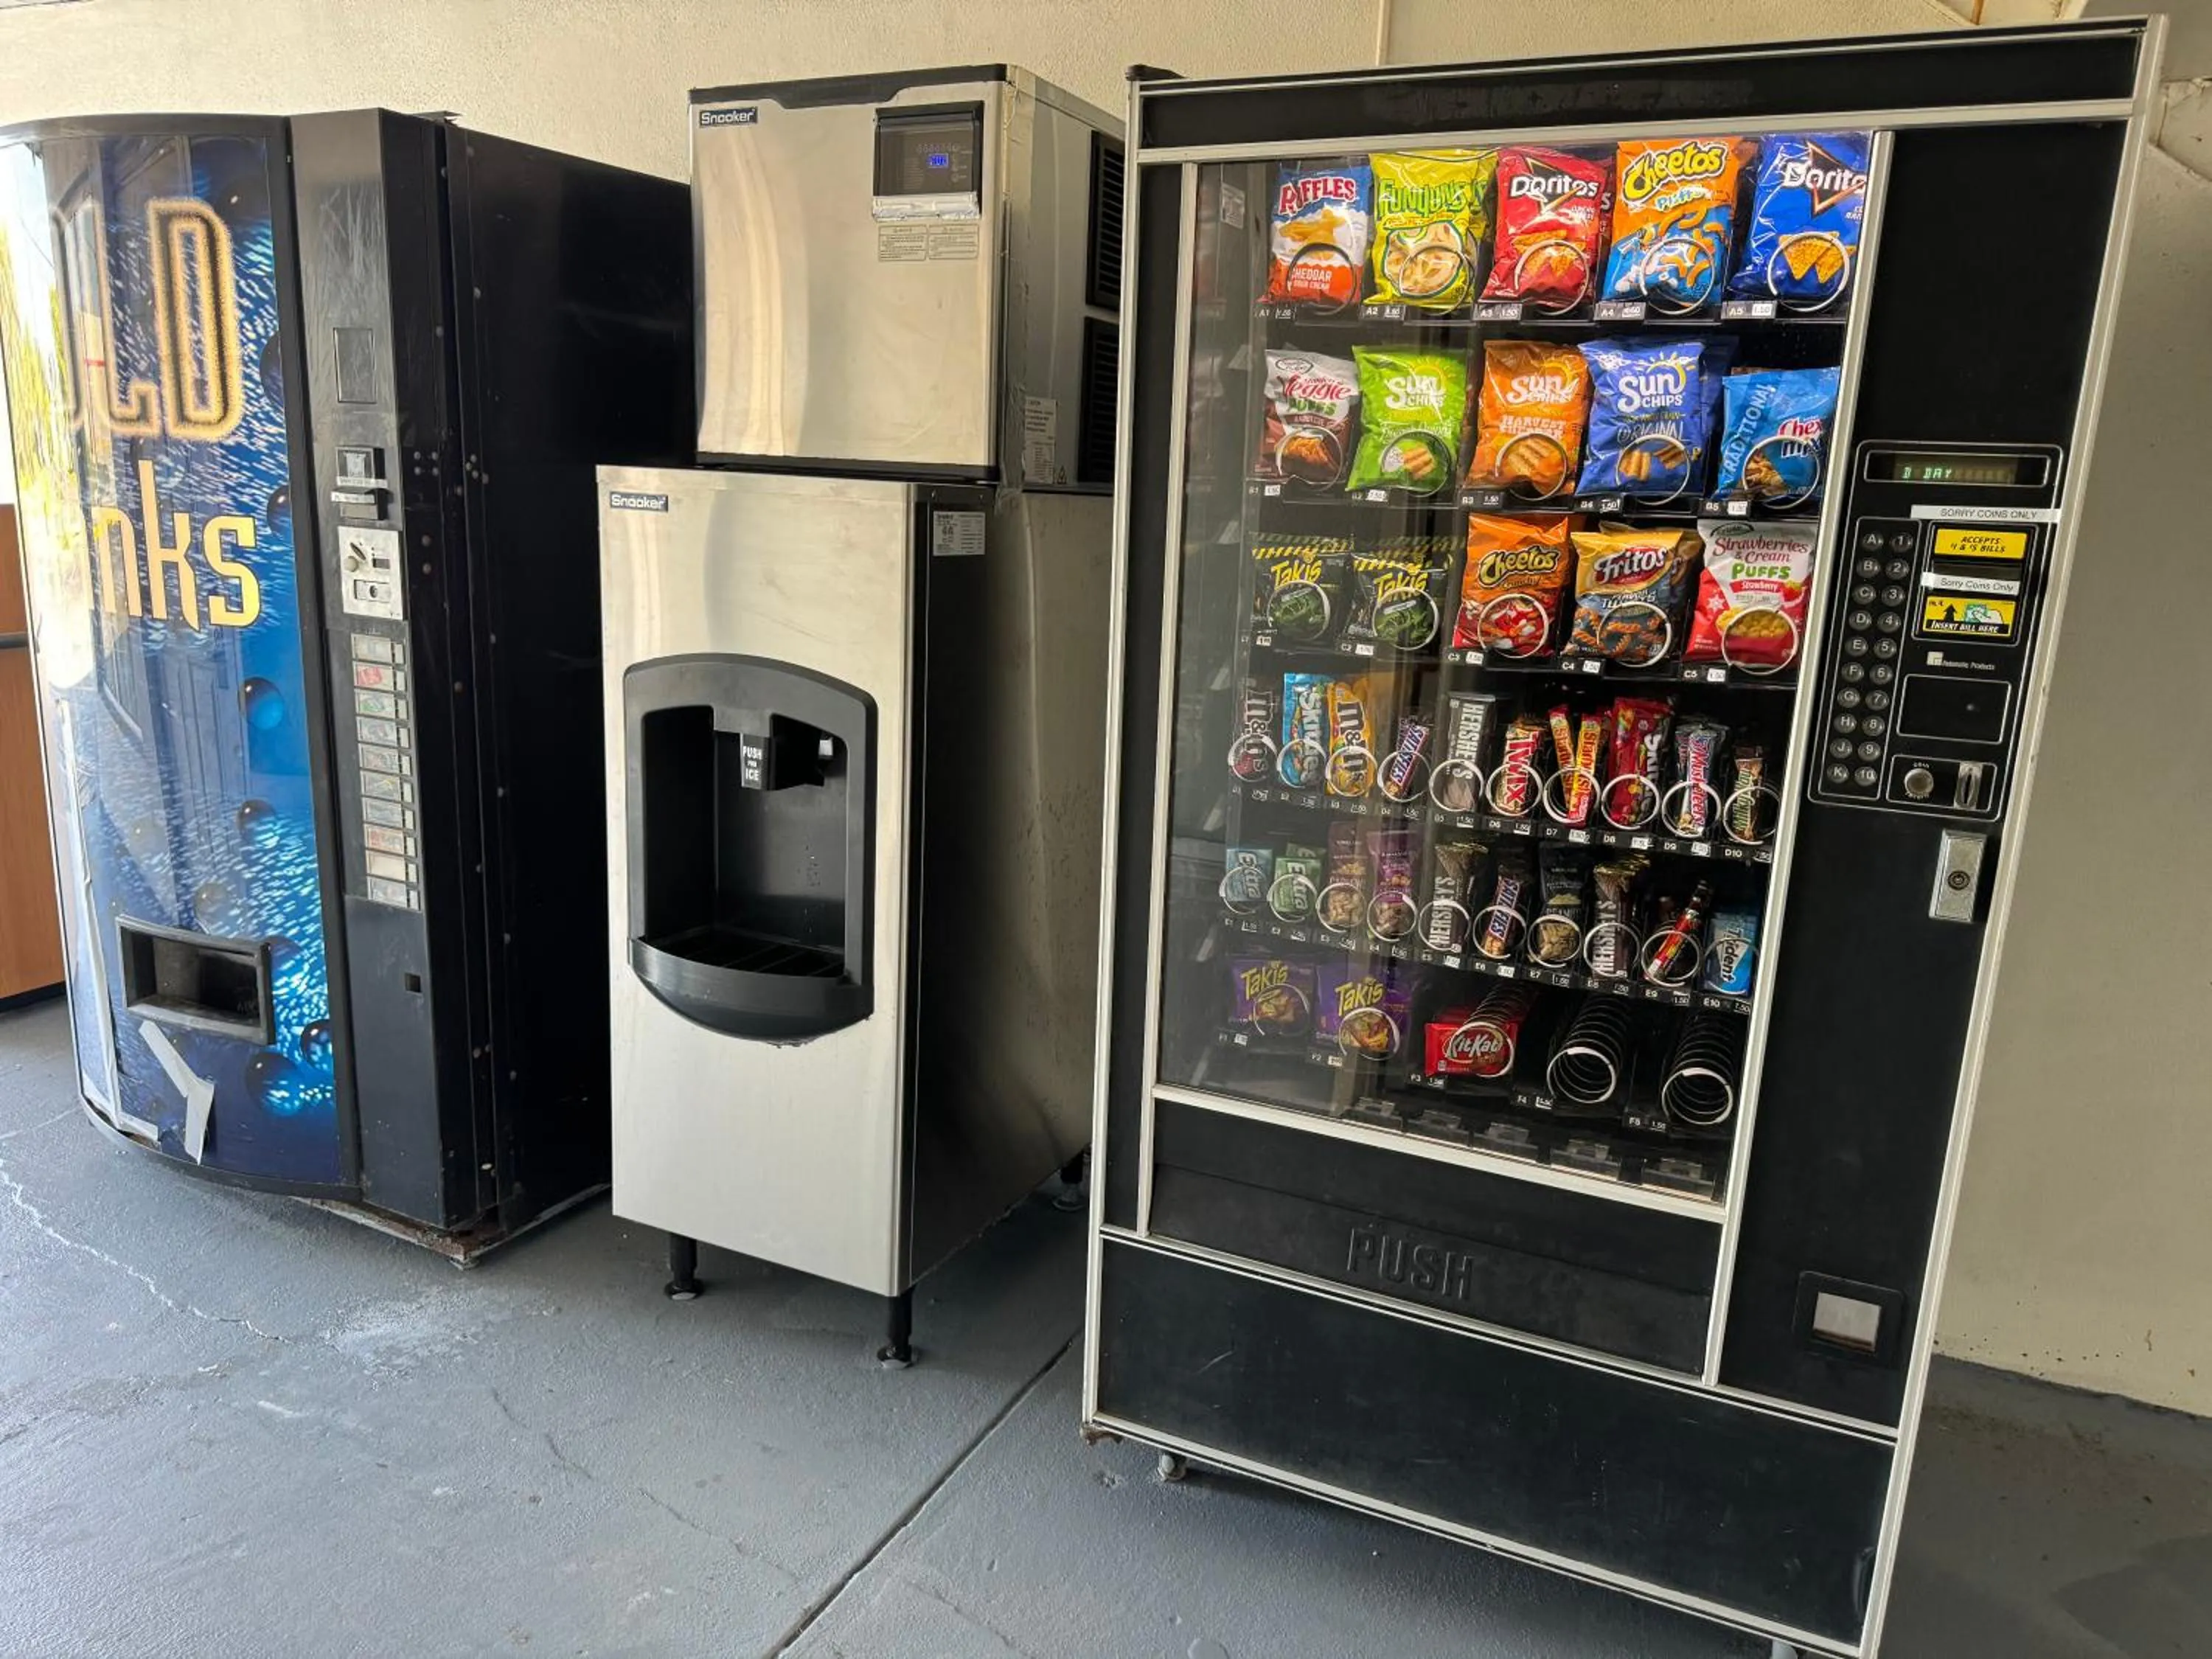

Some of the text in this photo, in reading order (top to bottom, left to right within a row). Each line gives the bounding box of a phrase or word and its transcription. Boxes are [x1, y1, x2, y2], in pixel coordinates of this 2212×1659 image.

[701, 108, 756, 125] Snooker
[1624, 140, 1725, 203] Cheetos
[1781, 160, 1868, 194] Dorito
[1510, 174, 1599, 198] Doritos
[1366, 307, 1378, 316] A2
[1480, 309, 1493, 317] A3
[1642, 394, 1684, 408] CHIPS
[1778, 416, 1823, 437] Chex
[611, 493, 666, 509] Snooker
[1940, 507, 2039, 520] SORRY COINS ONLY
[1867, 534, 1877, 544] A
[1897, 535, 1905, 546] 1
[1961, 536, 2002, 545] ACCEPTS
[1712, 534, 1809, 557] Strawberries
[1980, 545, 2006, 554] BILLS
[1745, 551, 1790, 563] Cream
[1479, 546, 1559, 585] Cheetos
[1593, 546, 1668, 585] Fritos
[1864, 561, 1873, 571] B
[1893, 563, 1902, 572] 2
[1270, 559, 1324, 591] Takis
[1374, 571, 1430, 605] Takis
[1940, 577, 2014, 592] Sorry Coins Only
[1860, 588, 1869, 598] C
[1889, 589, 1897, 599] 3
[1856, 613, 1865, 624] D
[1885, 616, 1893, 625] 4
[1931, 619, 1959, 631] INSERT
[1852, 641, 1861, 650] E
[1881, 641, 1889, 652] 5
[1562, 661, 1574, 670] C4
[1848, 665, 1857, 675] F
[1877, 667, 1885, 678] 6
[1873, 693, 1881, 703] 7
[1840, 717, 1851, 727] H
[742, 745, 762, 760] PUSH
[1837, 742, 1846, 752] J
[1865, 745, 1874, 755] 9
[745, 768, 759, 782] ICE
[1833, 767, 1843, 776] K
[1860, 769, 1874, 780] 10
[1546, 828, 1558, 836] D7
[1725, 849, 1742, 858] D10
[1489, 877, 1520, 942] SATIFIES
[1530, 970, 1541, 978] E7
[1240, 963, 1290, 1001] Takis
[1335, 978, 1385, 1017] Takis
[1703, 997, 1720, 1008] E10
[1346, 1228, 1475, 1301] PUSH
